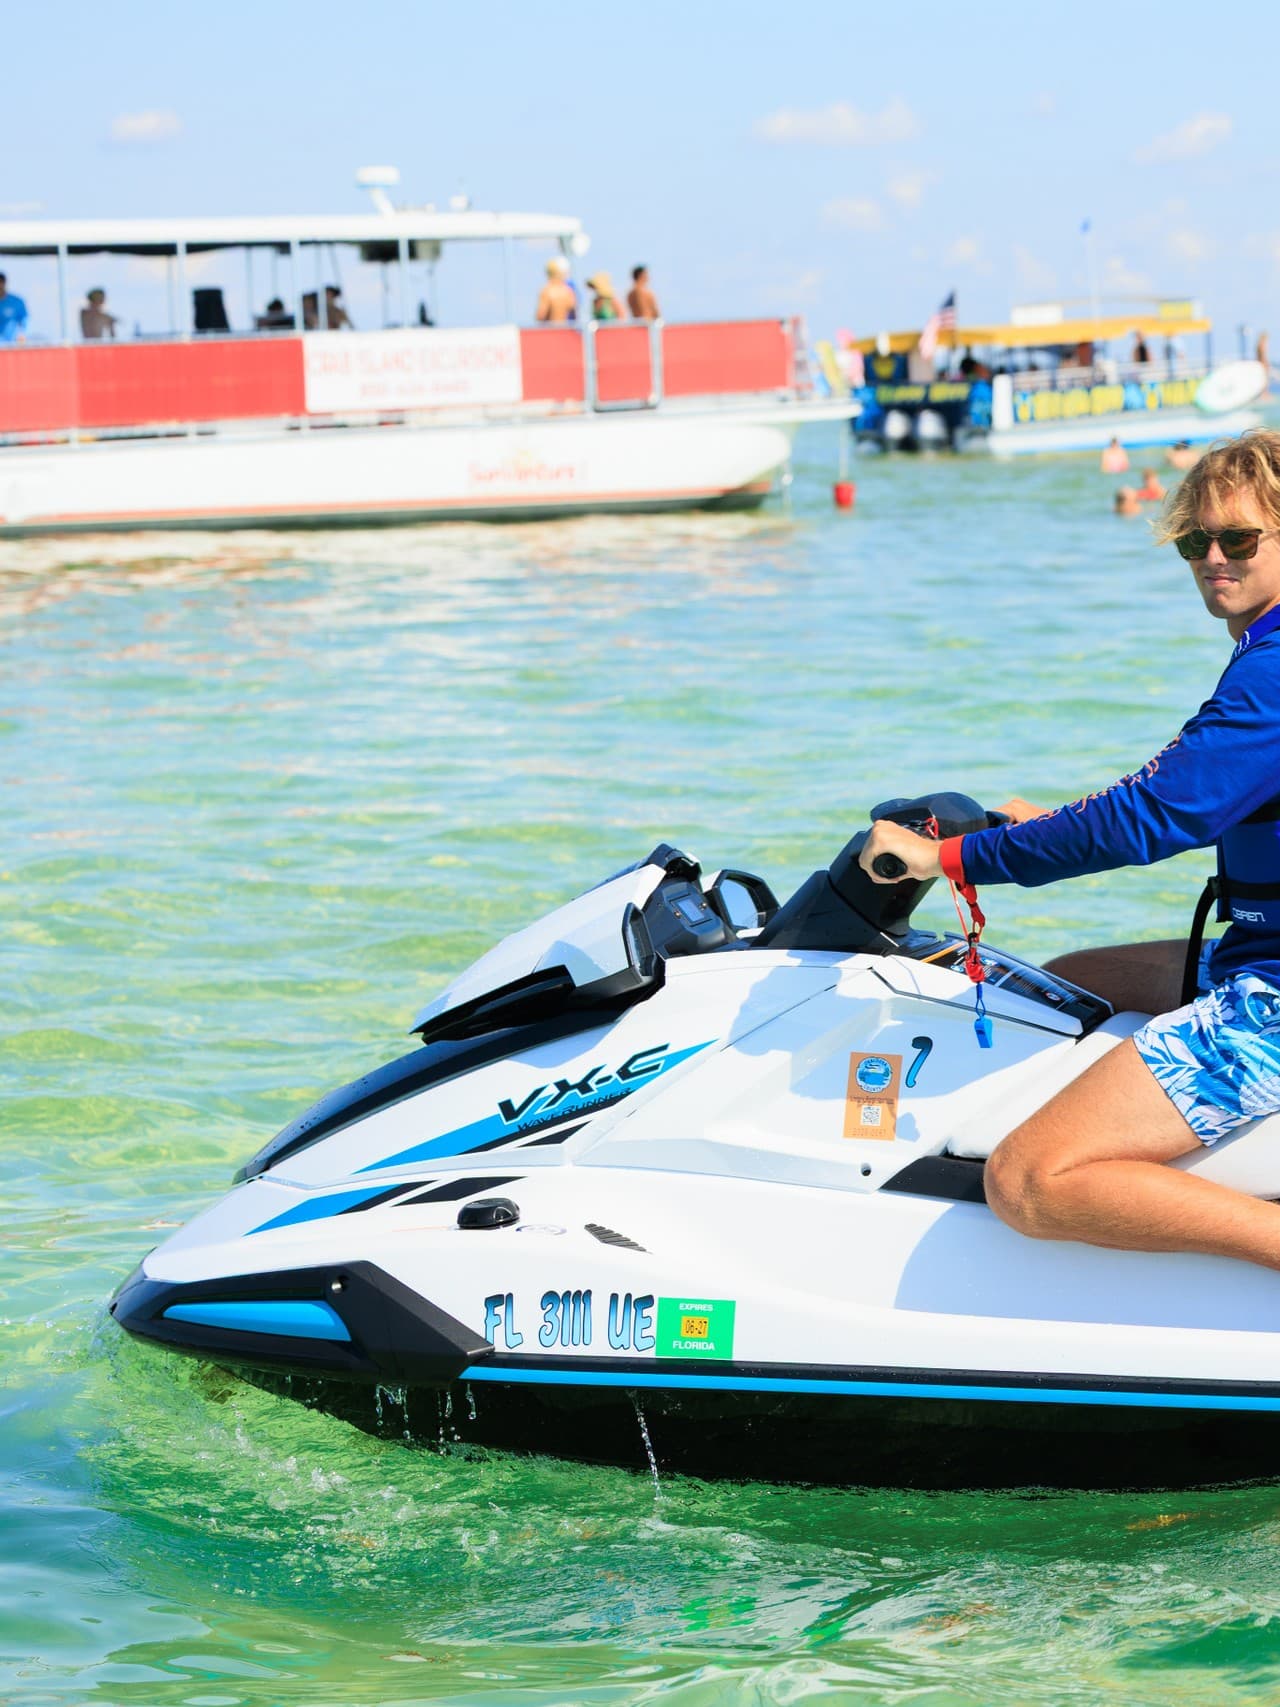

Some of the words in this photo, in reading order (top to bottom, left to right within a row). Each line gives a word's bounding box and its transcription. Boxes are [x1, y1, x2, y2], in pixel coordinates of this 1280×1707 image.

[498, 1042, 671, 1124] VX-C
[905, 1036, 933, 1088] 7
[484, 1292, 524, 1350] FL
[538, 1289, 593, 1348] 3111
[608, 1292, 656, 1352] UE
[679, 1303, 713, 1311] EXPIRES
[672, 1340, 715, 1351] FLORIDA
